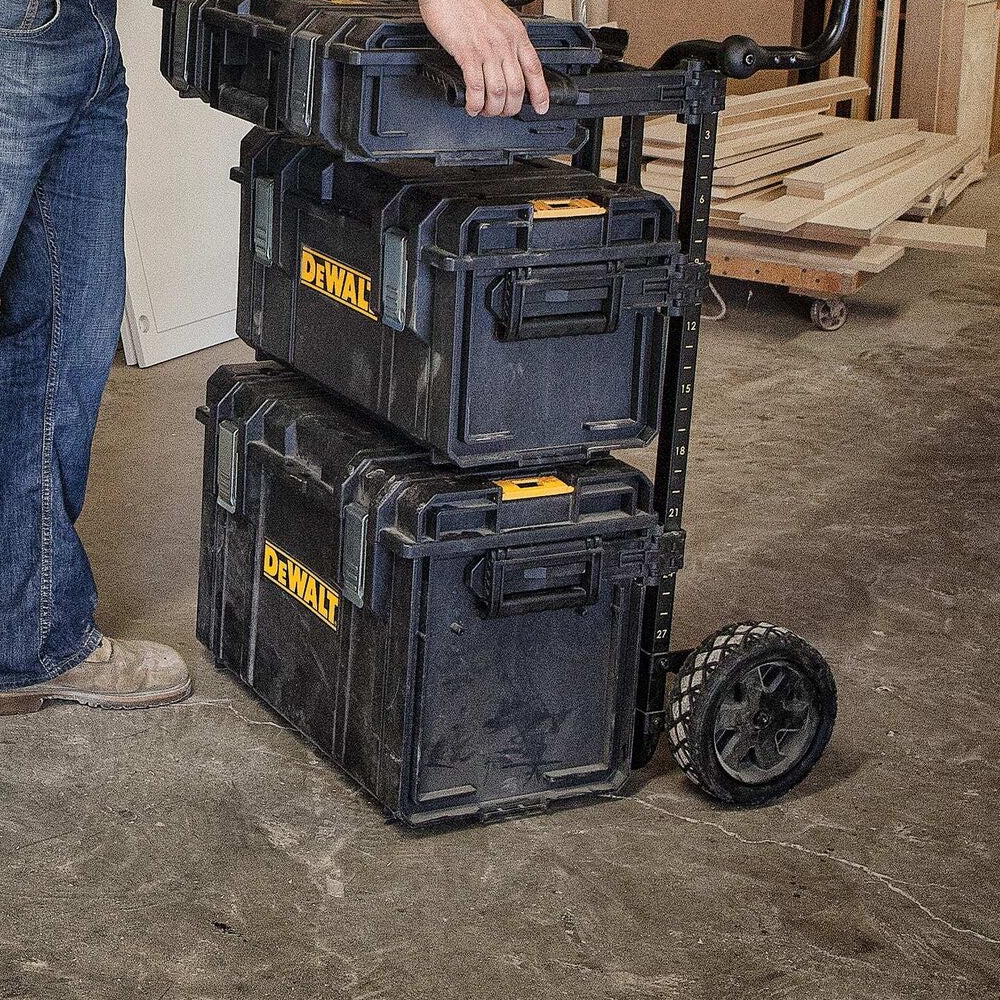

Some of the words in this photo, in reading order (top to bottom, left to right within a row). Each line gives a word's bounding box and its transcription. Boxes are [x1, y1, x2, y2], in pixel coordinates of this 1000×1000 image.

[704, 130, 710, 140] 3
[699, 194, 705, 204] 6
[301, 250, 372, 312] DEWAL
[687, 321, 697, 331] 12
[681, 384, 691, 394] 15
[676, 446, 686, 456] 18
[668, 507, 679, 518] 21
[656, 629, 668, 639] 27
